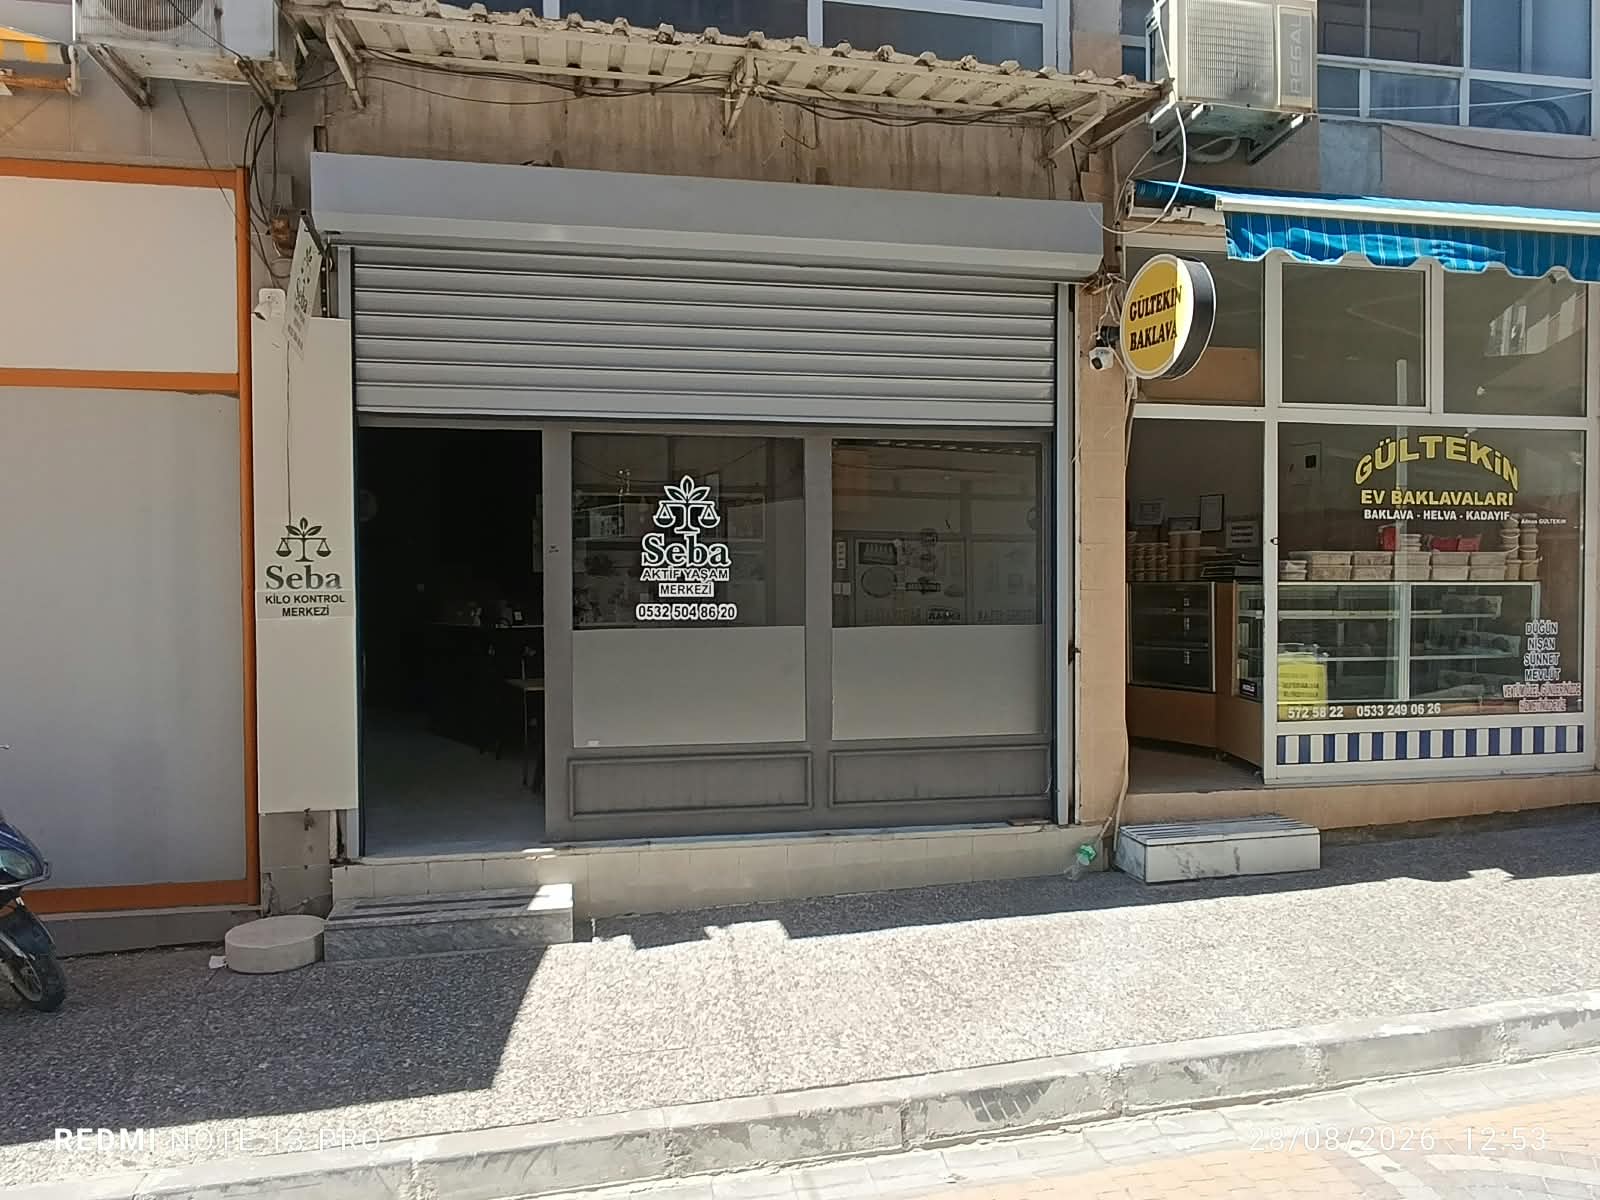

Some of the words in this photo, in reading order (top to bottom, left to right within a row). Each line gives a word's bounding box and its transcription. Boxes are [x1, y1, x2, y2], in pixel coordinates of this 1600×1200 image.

[1129, 284, 1182, 321] GÜLTEKİN
[1129, 320, 1178, 351] BAKLAVA
[1361, 489, 1386, 505] EV
[1391, 489, 1514, 506] BAKLAVALARI
[1364, 509, 1414, 521] BAKLAVA
[1423, 509, 1457, 521] HELVA
[1466, 510, 1510, 521] KADAYIF
[641, 533, 732, 567] Seba
[266, 564, 343, 590] Seba
[640, 566, 685, 581] AKTİF
[685, 567, 729, 583] YAŞAM
[659, 581, 714, 597] MERKEZİ
[265, 593, 291, 604] KİLO
[294, 594, 346, 604] KONTROL
[282, 605, 329, 617] MERKEZİ
[636, 603, 670, 620] 0532
[673, 603, 697, 620] 504
[700, 603, 718, 620] 86
[718, 603, 737, 620] 20
[1527, 634, 1556, 651] NİŞAN
[1524, 651, 1560, 666] SÜNNET
[1288, 706, 1309, 719] 572
[1329, 706, 1344, 718] 22
[1356, 704, 1384, 717] 0533
[1387, 704, 1408, 716] 249
[1410, 703, 1425, 715] 06
[1427, 703, 1441, 715] 26
